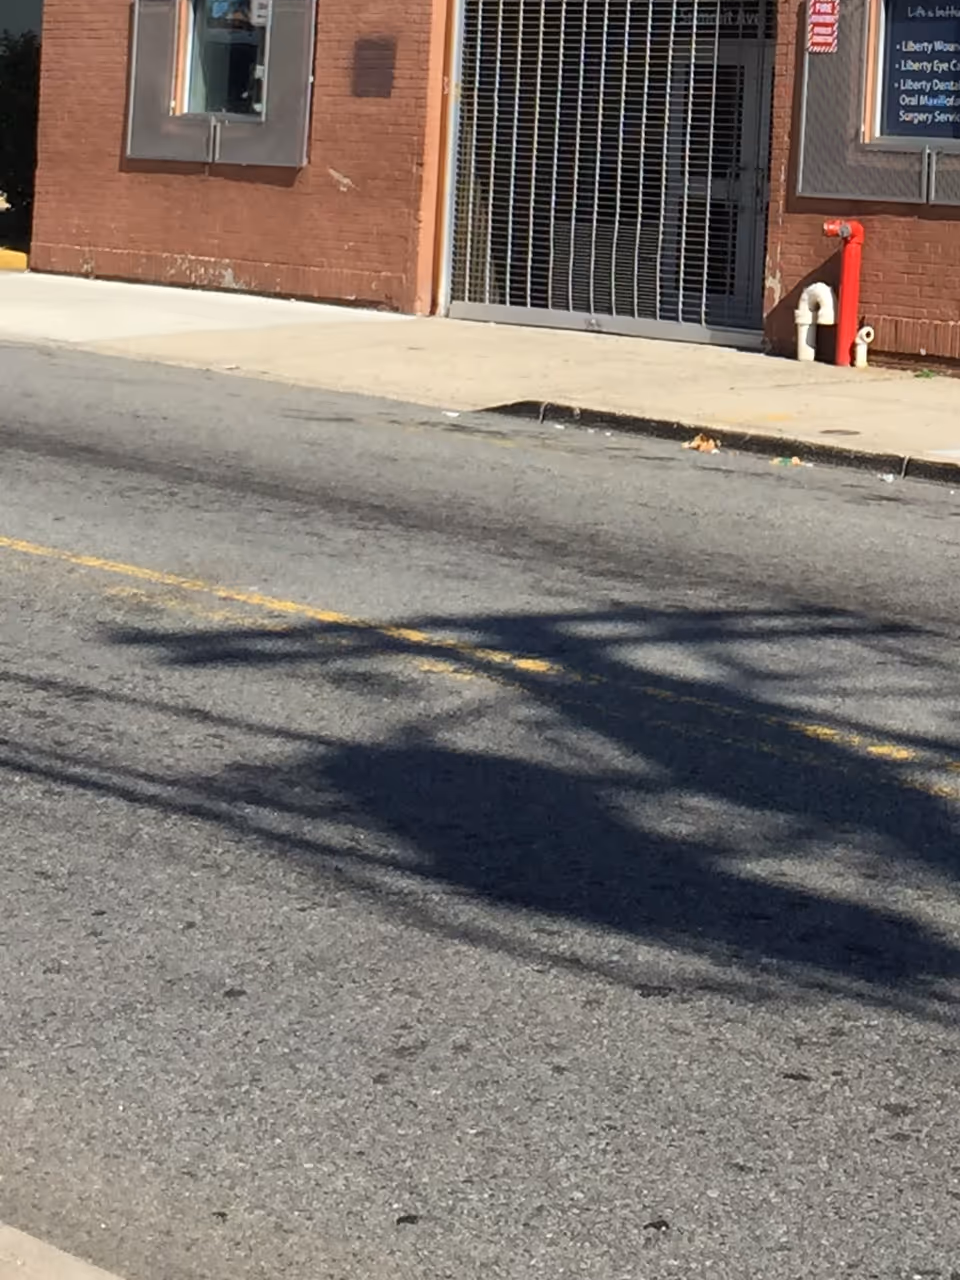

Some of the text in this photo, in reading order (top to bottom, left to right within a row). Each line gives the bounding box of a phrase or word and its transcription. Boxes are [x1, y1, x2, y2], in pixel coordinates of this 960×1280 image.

[902, 40, 932, 54] Liberty
[901, 59, 933, 73] Liberty
[933, 60, 949, 73] Eye
[900, 79, 931, 92] Liberty
[933, 80, 960, 90] Dental
[899, 94, 918, 106] Oral
[899, 110, 933, 124] Surgery
